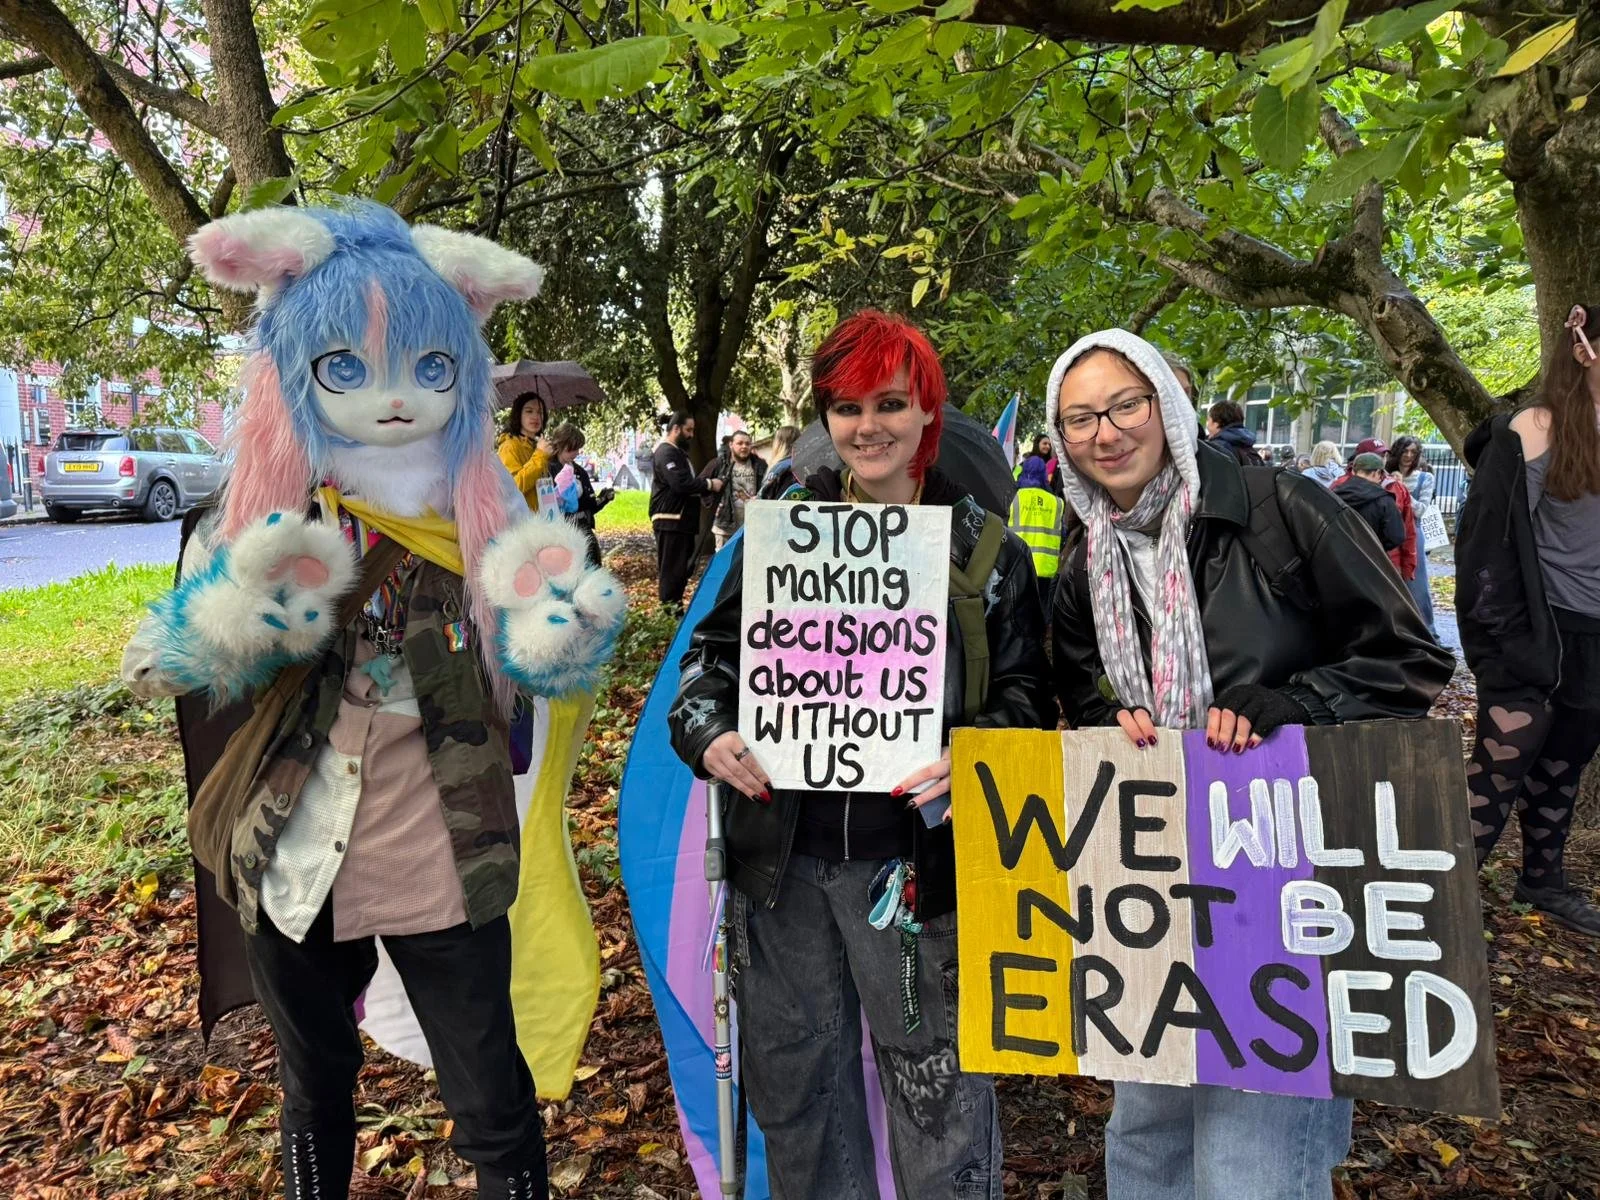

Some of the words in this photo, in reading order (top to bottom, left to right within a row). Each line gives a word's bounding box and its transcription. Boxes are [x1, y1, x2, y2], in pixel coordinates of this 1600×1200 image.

[787, 503, 909, 562] STOP
[748, 658, 863, 698] about
[755, 701, 934, 744] WITHOUT
[803, 743, 865, 789] US
[974, 760, 1181, 872] WE
[1208, 775, 1457, 872] WILL
[1017, 883, 1237, 948] NOT
[1280, 880, 1443, 961] BE
[990, 951, 1478, 1079] ERASED
